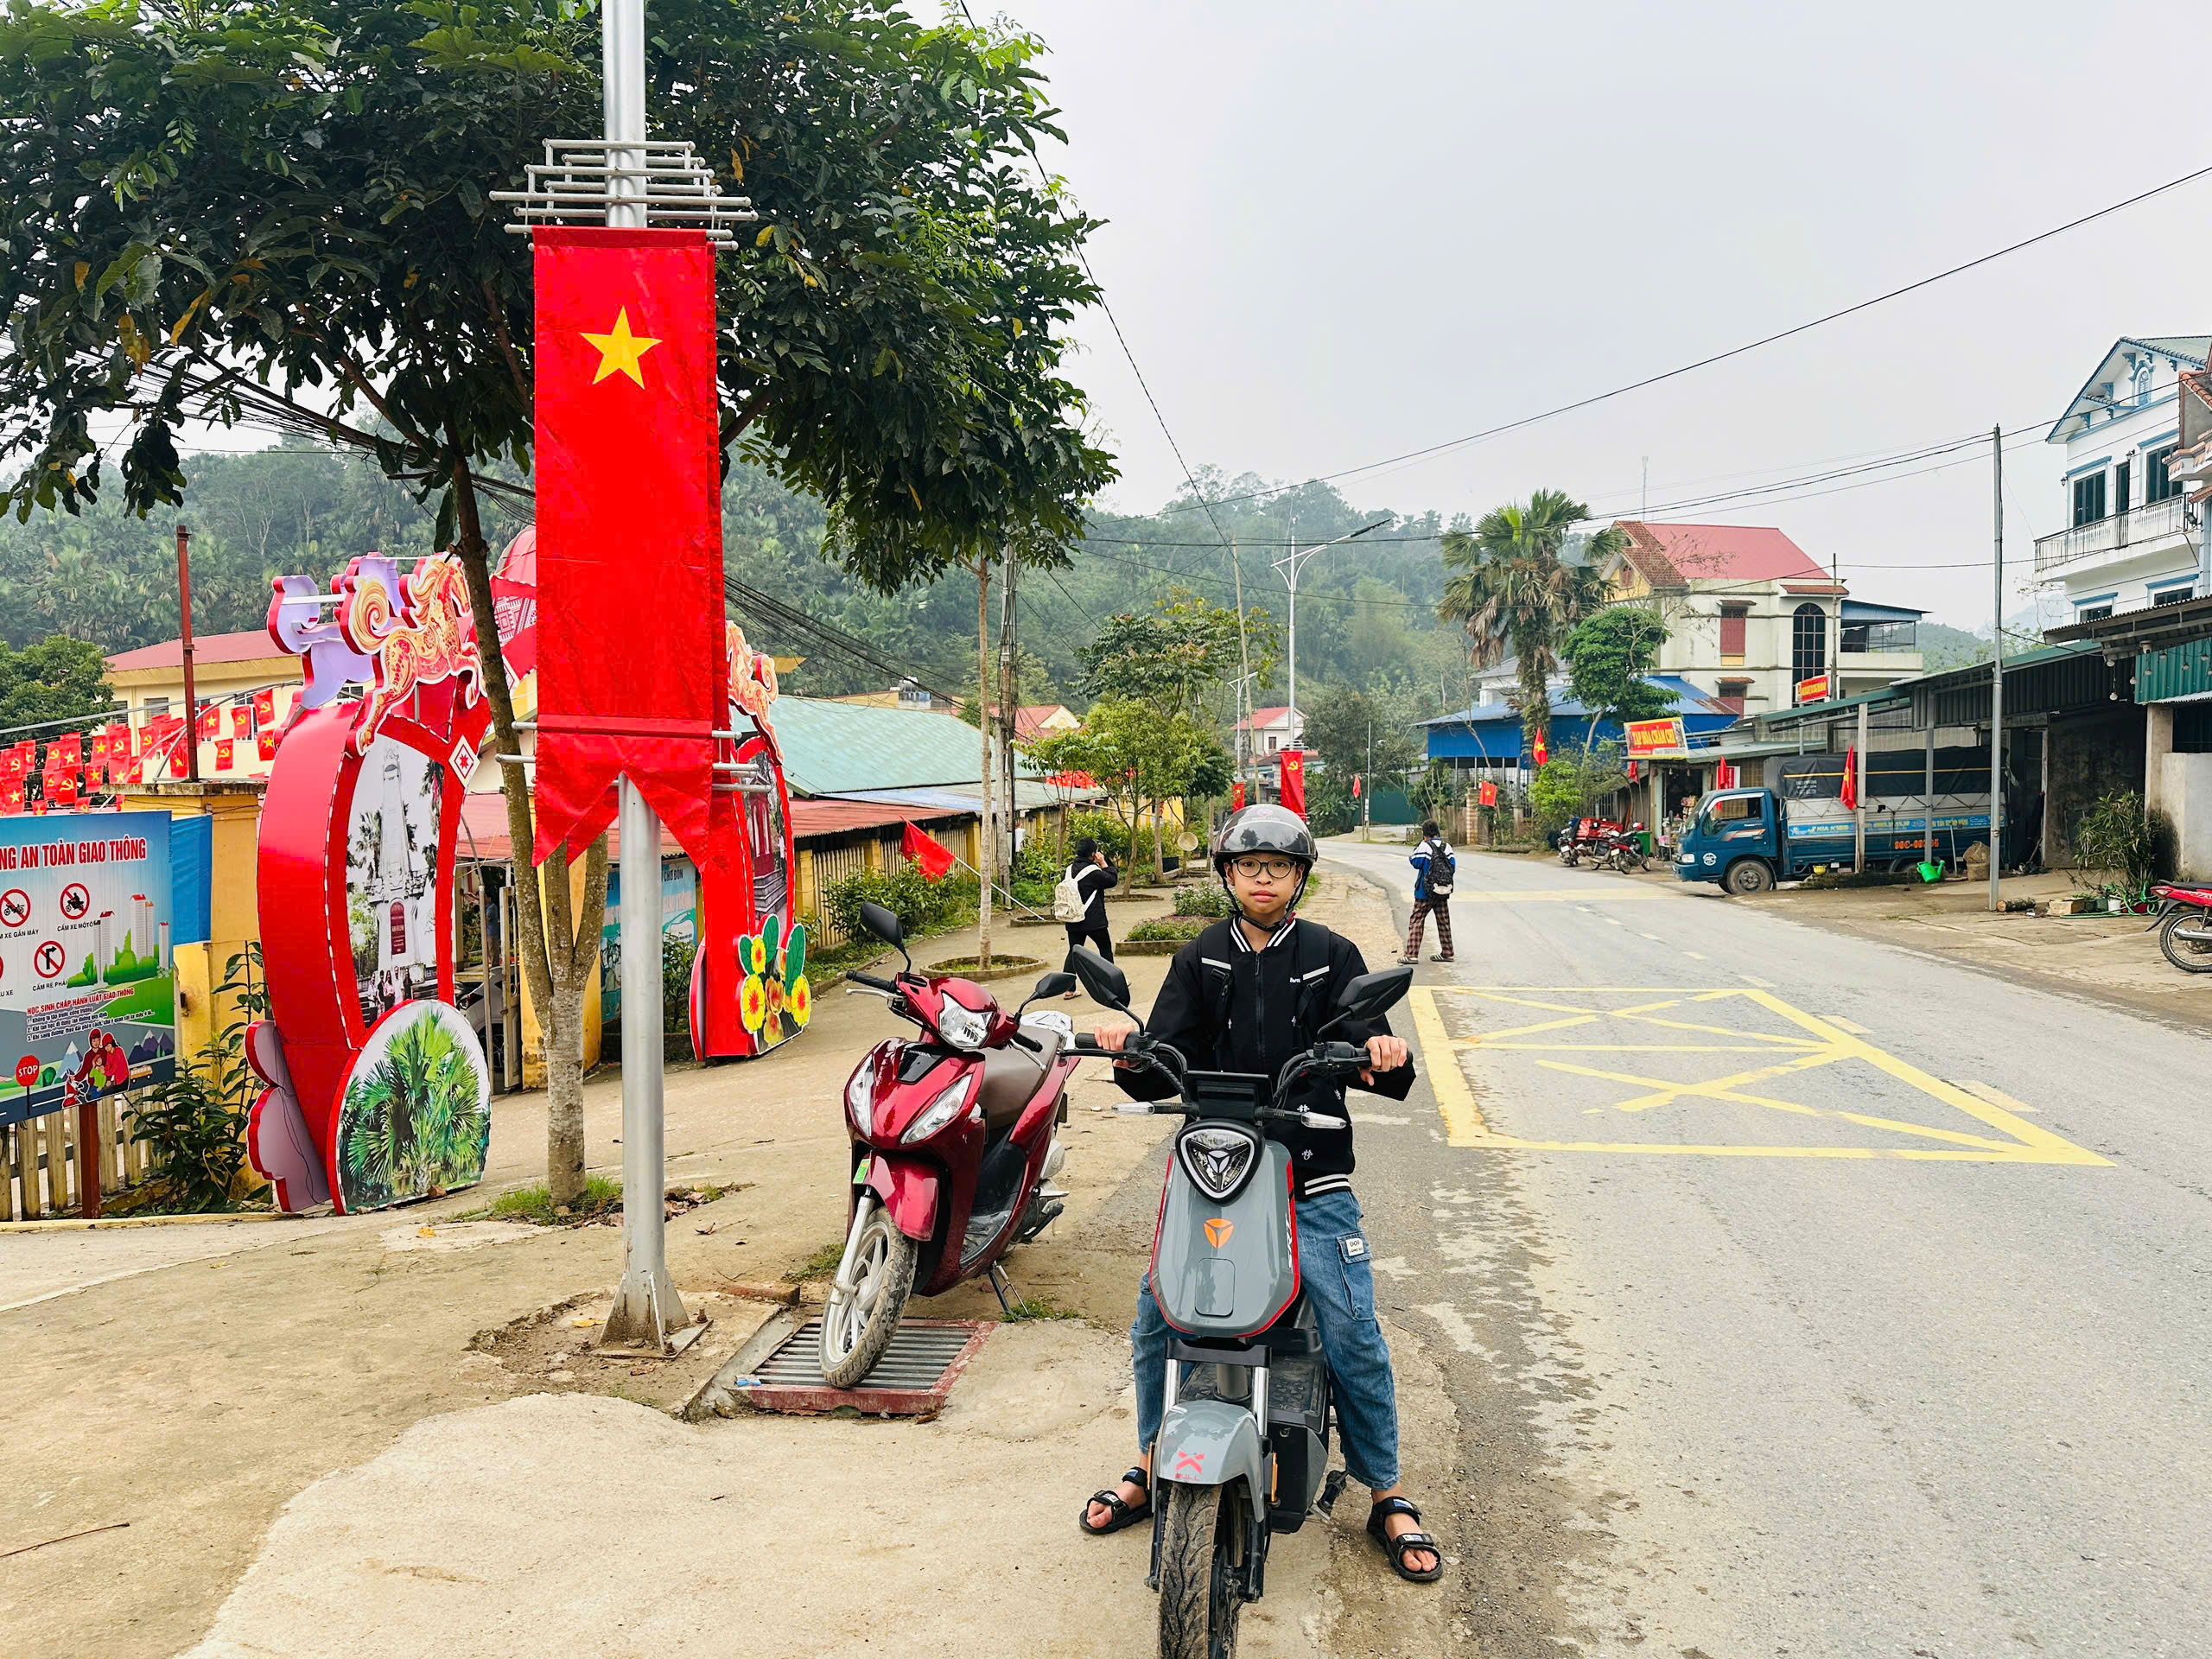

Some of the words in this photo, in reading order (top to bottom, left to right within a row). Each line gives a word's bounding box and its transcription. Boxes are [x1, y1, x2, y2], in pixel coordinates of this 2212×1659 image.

[21, 846, 38, 868] AN
[42, 840, 75, 867] TOÀN
[79, 842, 105, 864] GIAO
[109, 836, 146, 861] THÔNG
[41, 1003, 54, 1012] SINH
[118, 988, 134, 996] THÔNG
[908, 1049, 931, 1058] HONDA
[18, 1065, 39, 1077] STOP
